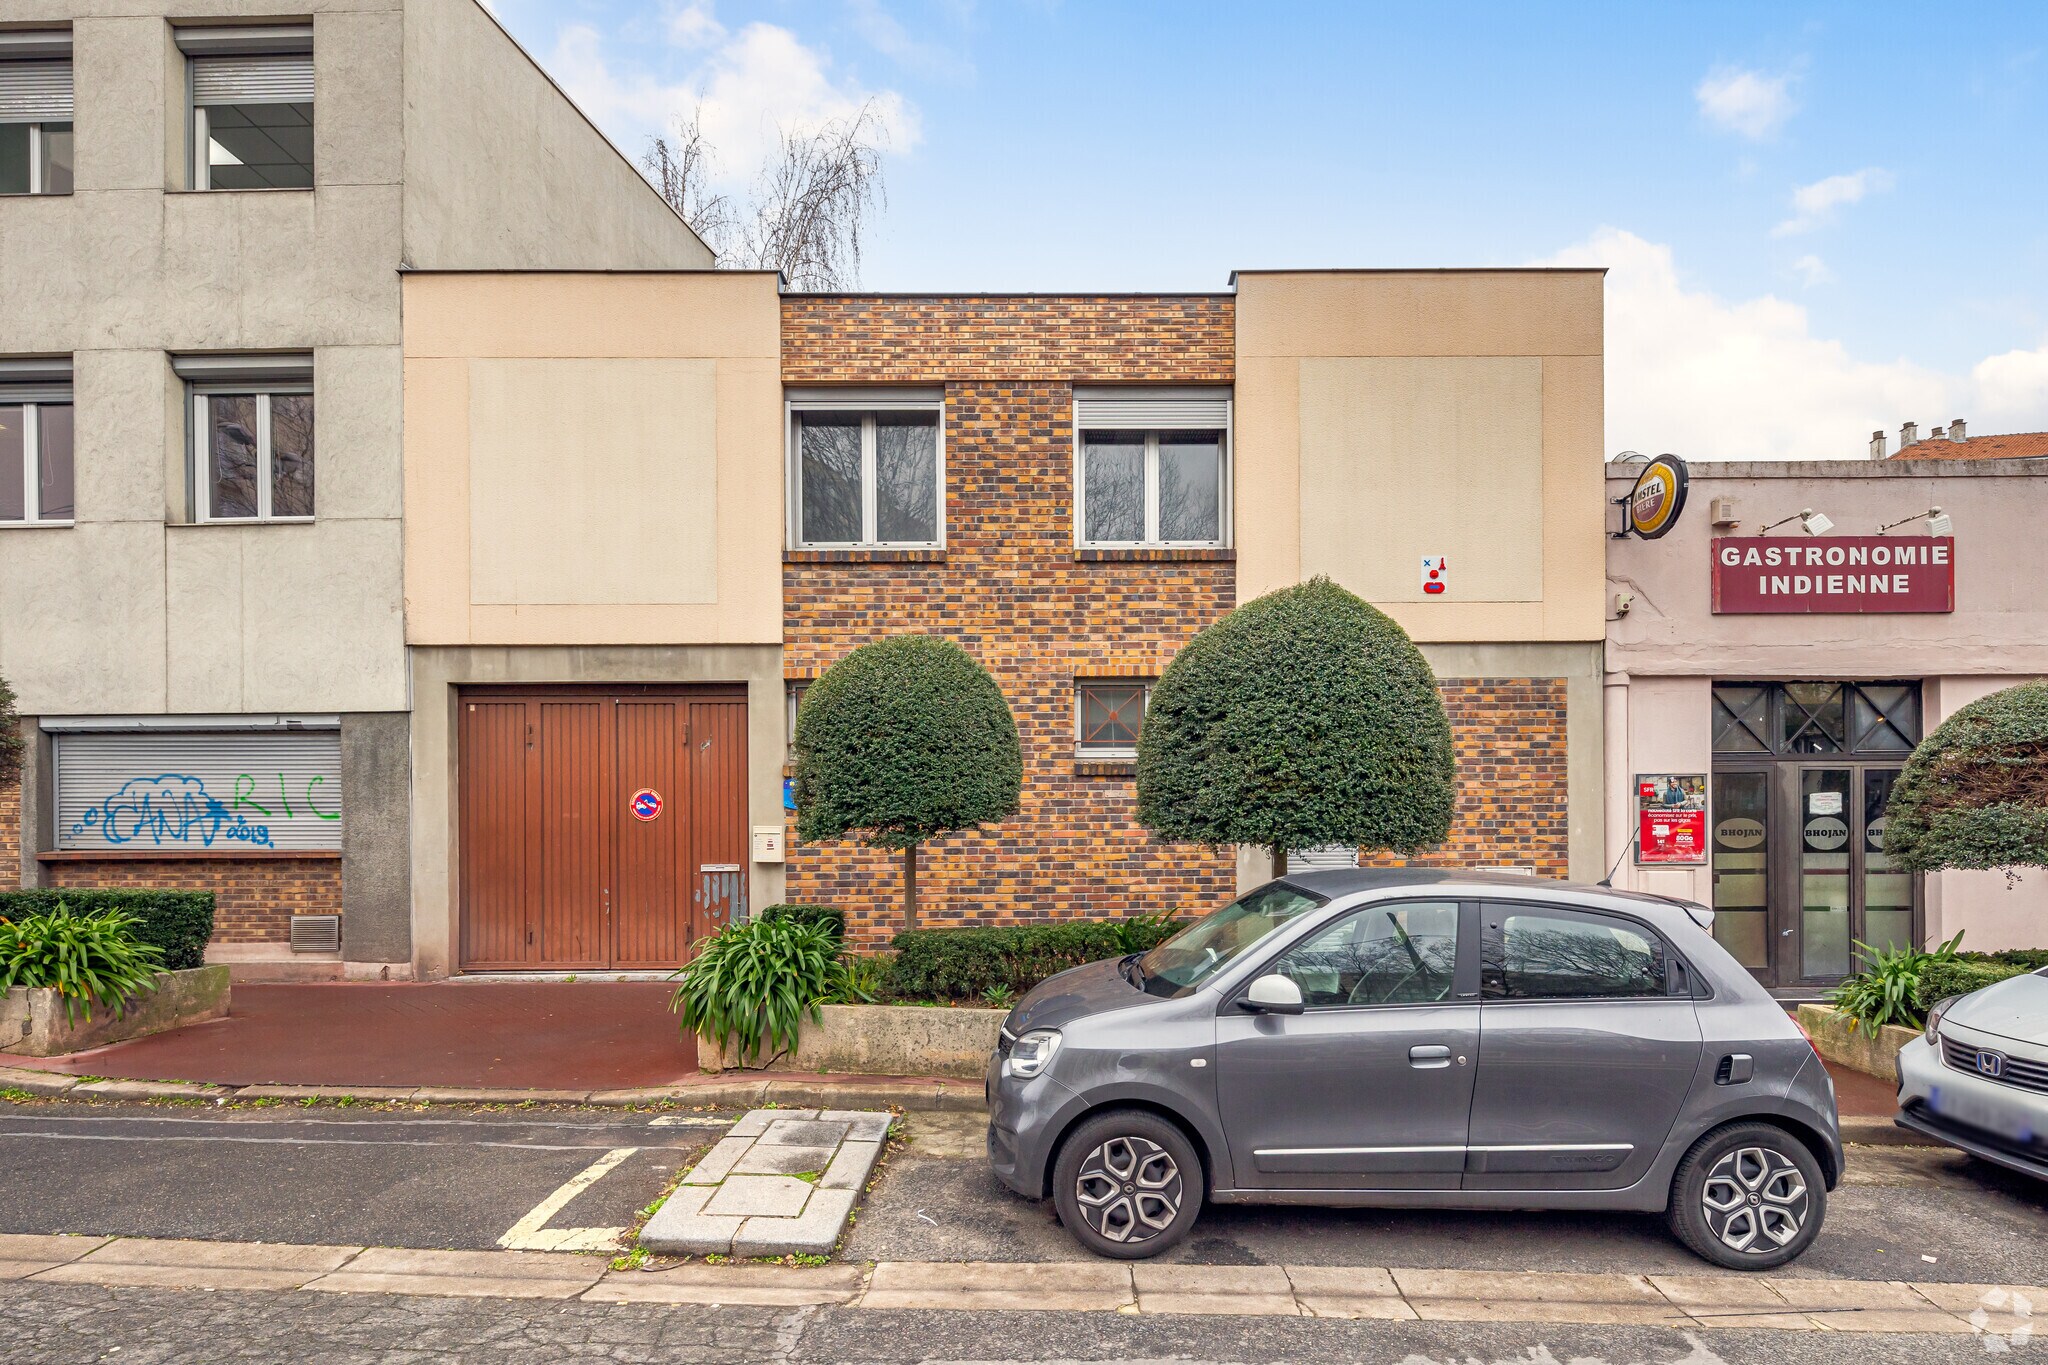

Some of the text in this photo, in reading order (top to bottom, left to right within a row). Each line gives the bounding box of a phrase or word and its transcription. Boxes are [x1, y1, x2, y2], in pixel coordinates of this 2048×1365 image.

[1720, 546, 1948, 566] GASTRONOMIE
[1759, 575, 1909, 594] INDIENNE
[1721, 829, 1763, 838] BHOJAN
[1805, 829, 1846, 838] BHOJAN
